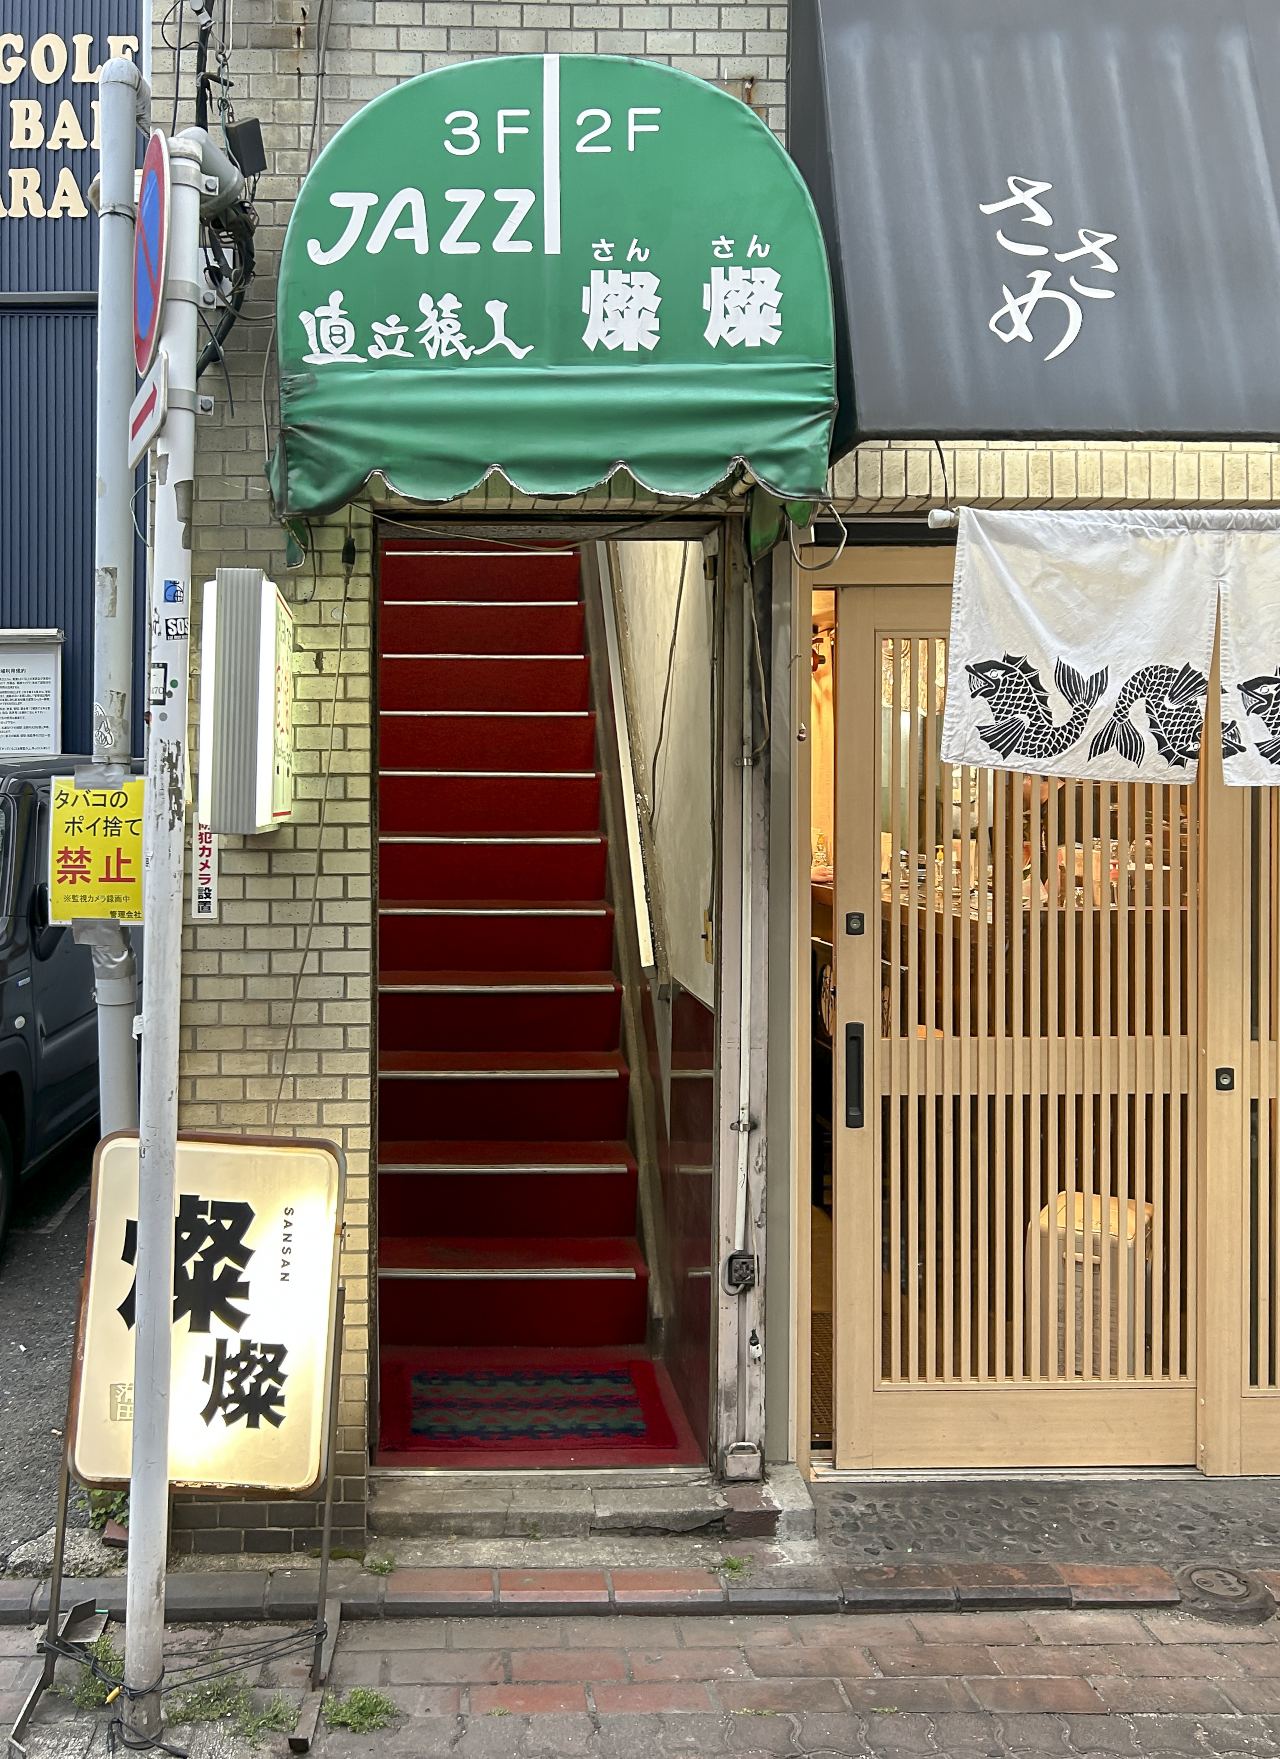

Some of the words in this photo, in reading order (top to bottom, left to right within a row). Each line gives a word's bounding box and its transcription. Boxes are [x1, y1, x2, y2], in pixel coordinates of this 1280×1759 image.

[10, 100, 100, 150] BA
[444, 110, 531, 156] 3F
[576, 107, 662, 153] 2F
[307, 187, 536, 266] JAZZ
[299, 290, 535, 365] 直立猿人
[55, 789, 129, 809] タバコの
[64, 815, 143, 837] ポイ捨て
[56, 846, 136, 885] 禁止
[109, 910, 143, 919] 管理会社
[280, 1207, 295, 1283] SANSAN
